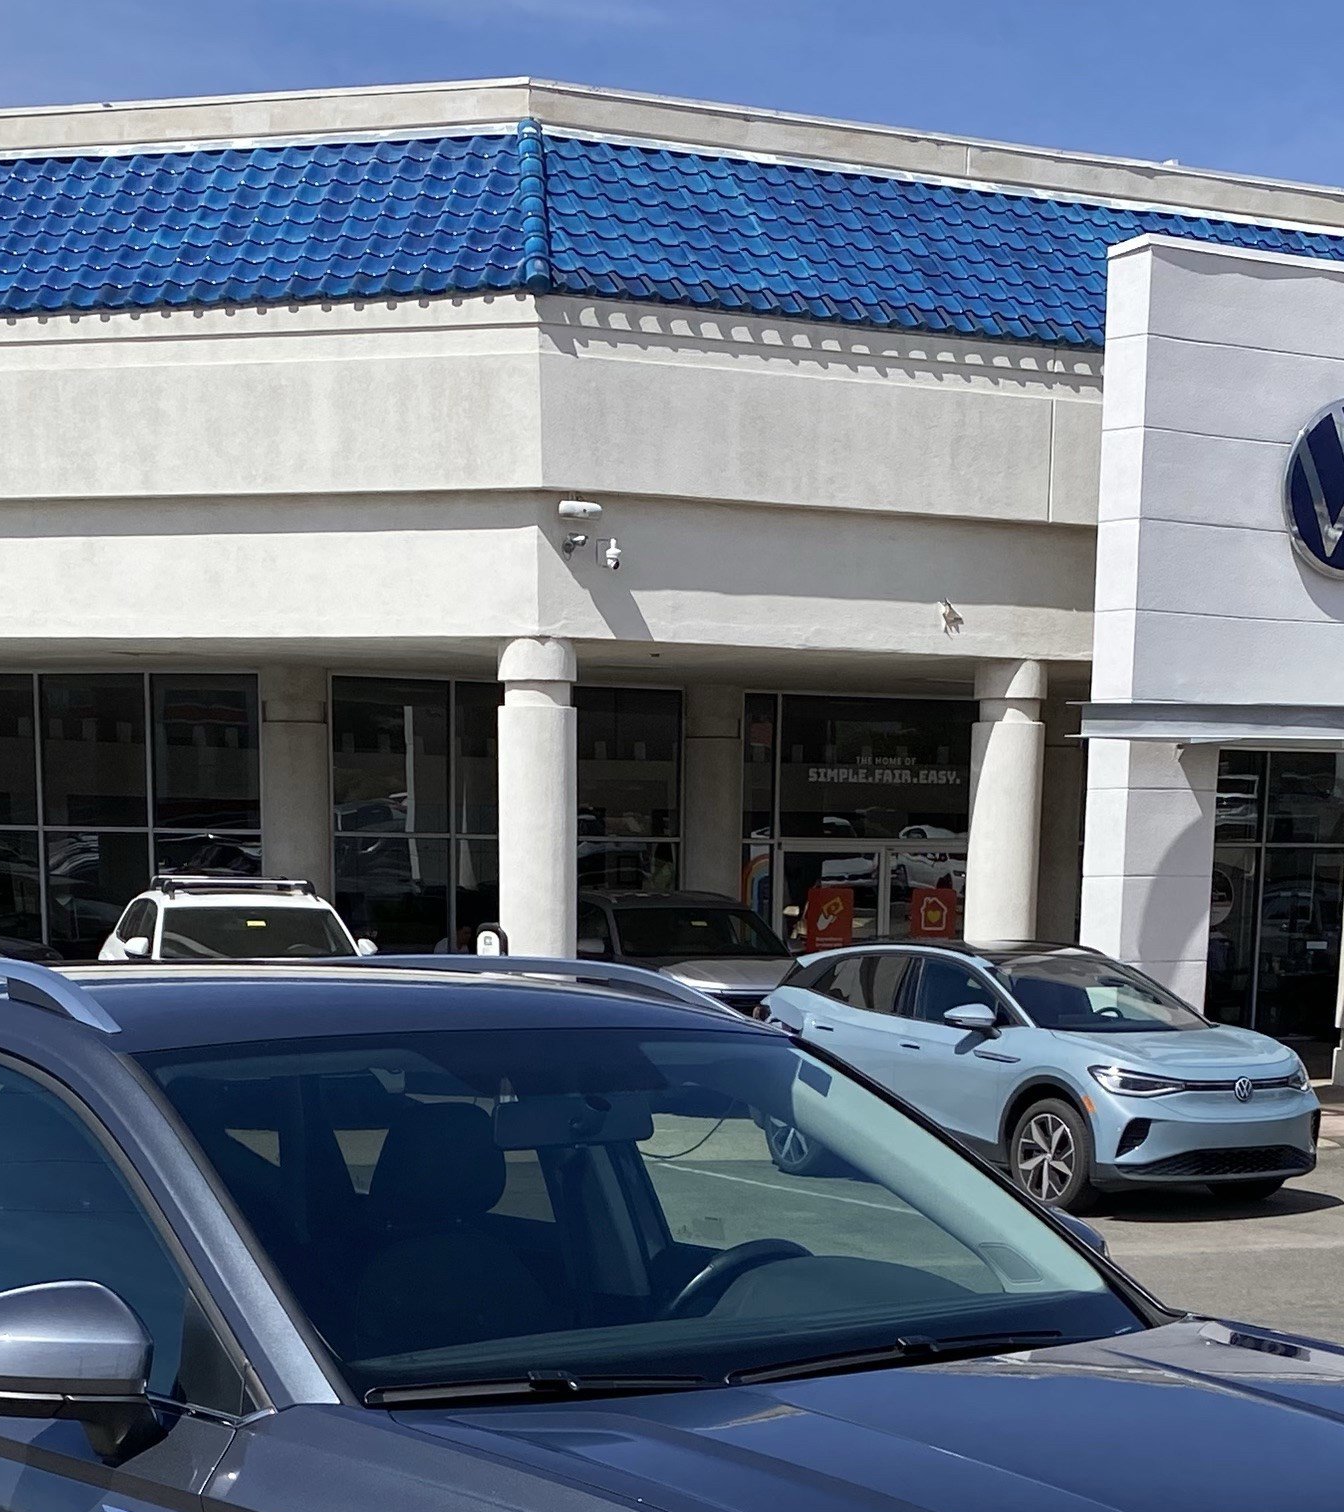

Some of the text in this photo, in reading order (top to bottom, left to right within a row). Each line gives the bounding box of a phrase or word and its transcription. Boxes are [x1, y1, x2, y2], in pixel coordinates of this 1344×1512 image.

[856, 756, 917, 766] THE HOME OF
[1235, 1077, 1252, 1100] VW
